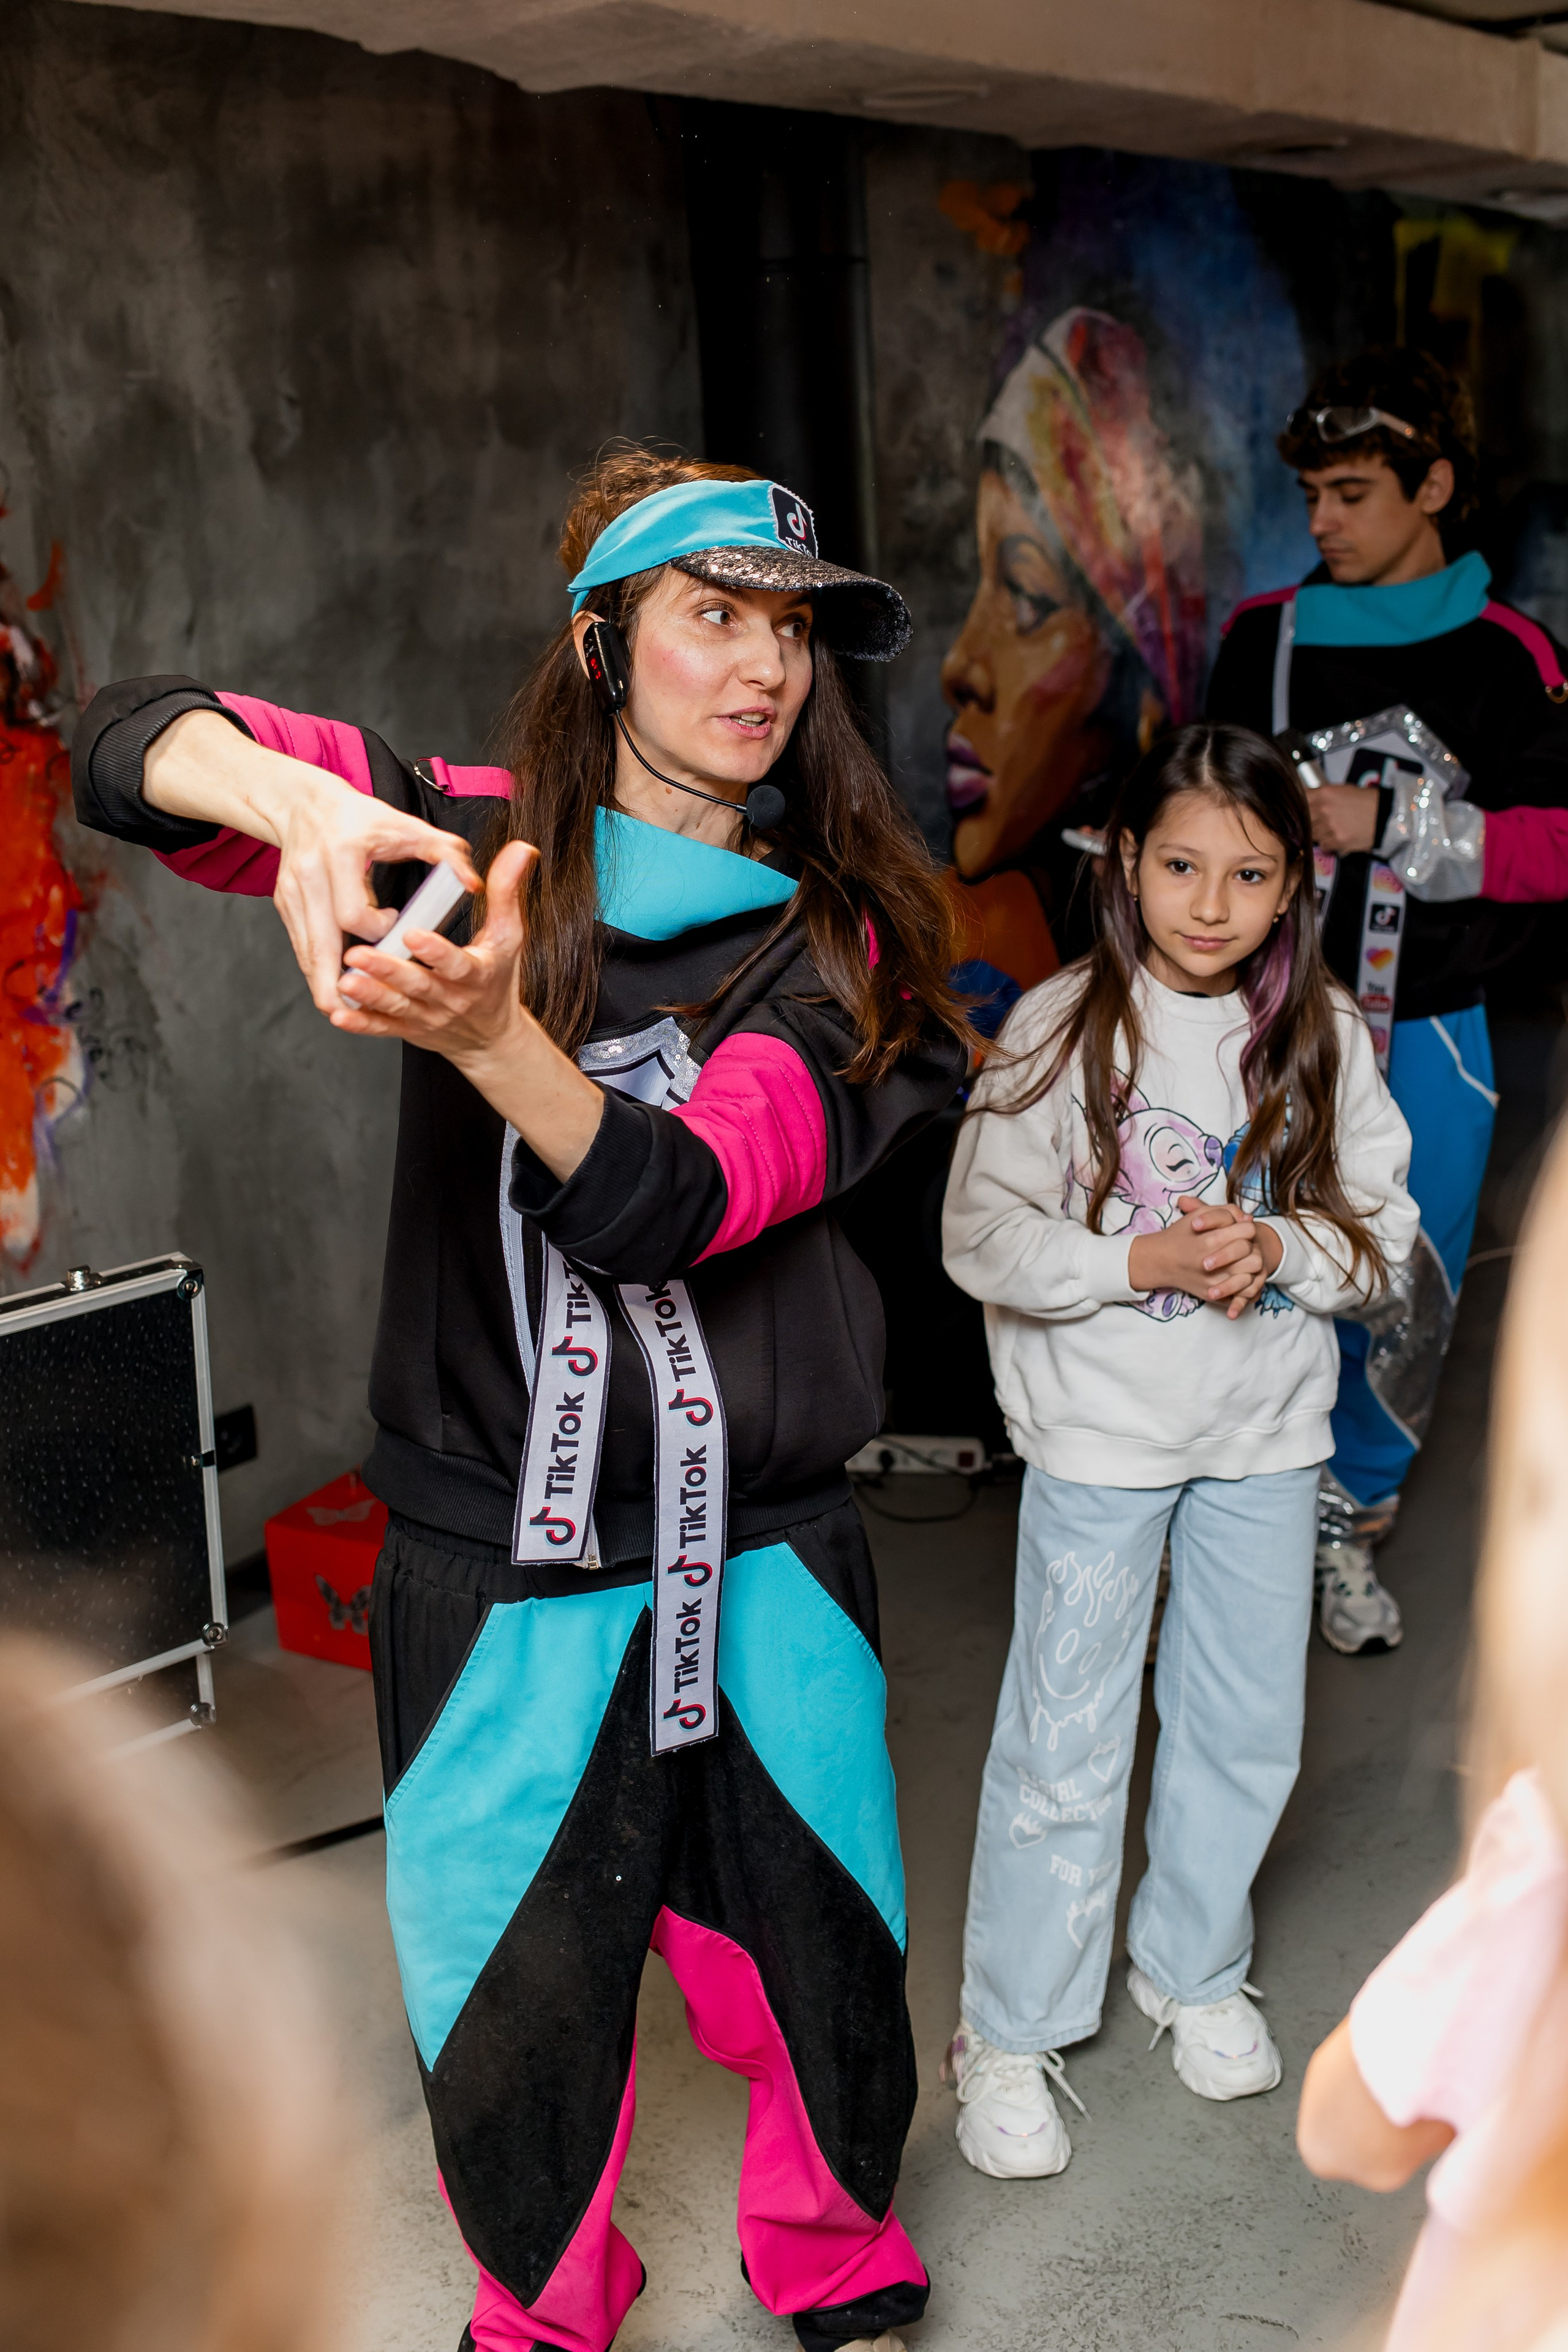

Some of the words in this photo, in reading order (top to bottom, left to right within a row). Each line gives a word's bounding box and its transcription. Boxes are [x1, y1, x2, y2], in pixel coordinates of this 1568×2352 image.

[785, 537, 812, 556] TikTo
[562, 1260, 592, 1329] TikT
[645, 1280, 696, 1382] TikTok
[545, 1391, 585, 1499] TikTok
[679, 1444, 706, 1549] TikTok
[674, 1597, 702, 1694] TikTok
[1049, 1853, 1083, 1887] FOR
